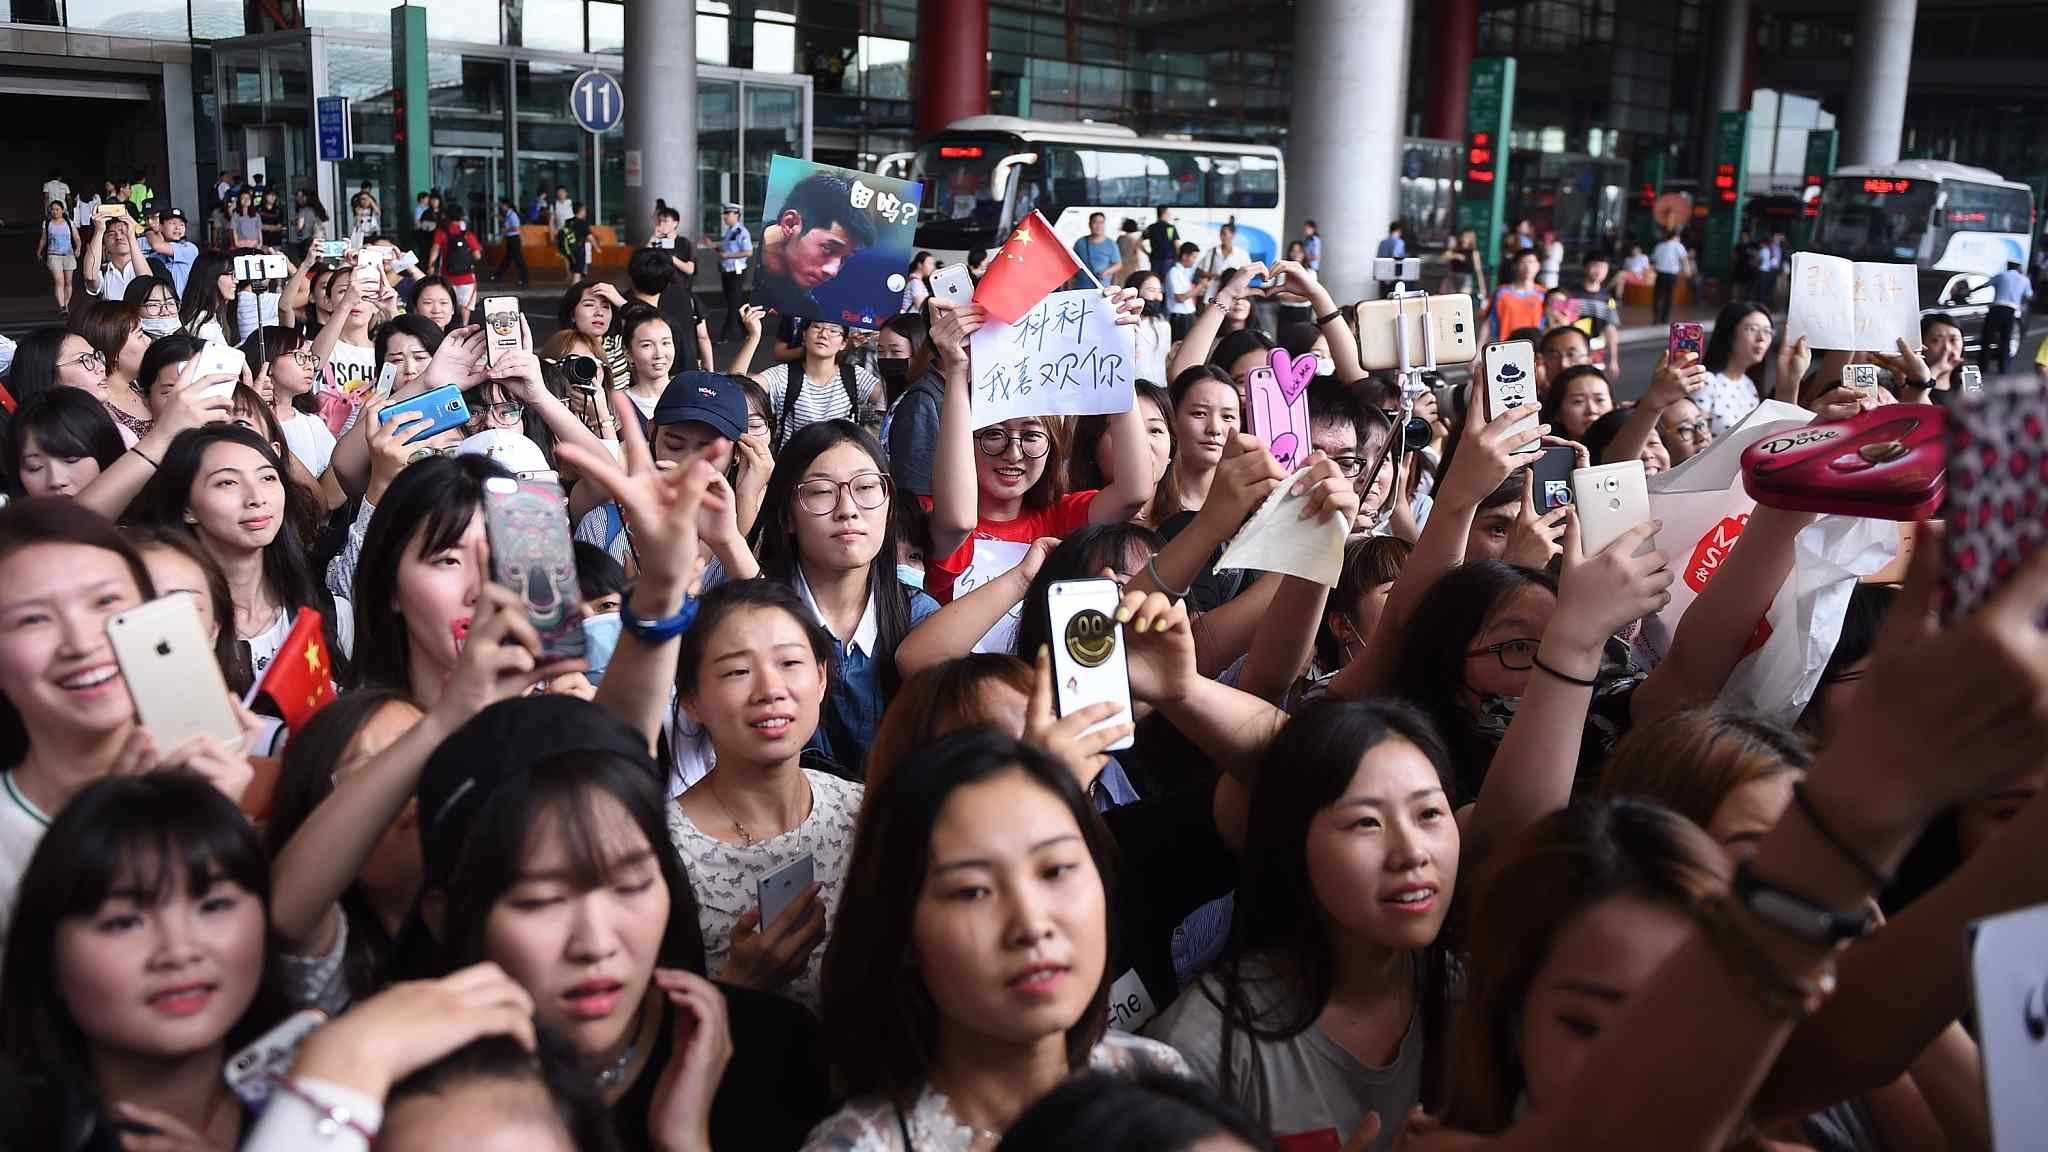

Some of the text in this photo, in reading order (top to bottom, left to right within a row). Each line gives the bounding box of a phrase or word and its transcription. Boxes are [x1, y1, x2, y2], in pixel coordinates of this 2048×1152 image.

[580, 81, 610, 123] 11
[1013, 299, 1094, 352] 科科
[978, 346, 1126, 403] 我喜欢你
[1761, 431, 1840, 454] Dove
